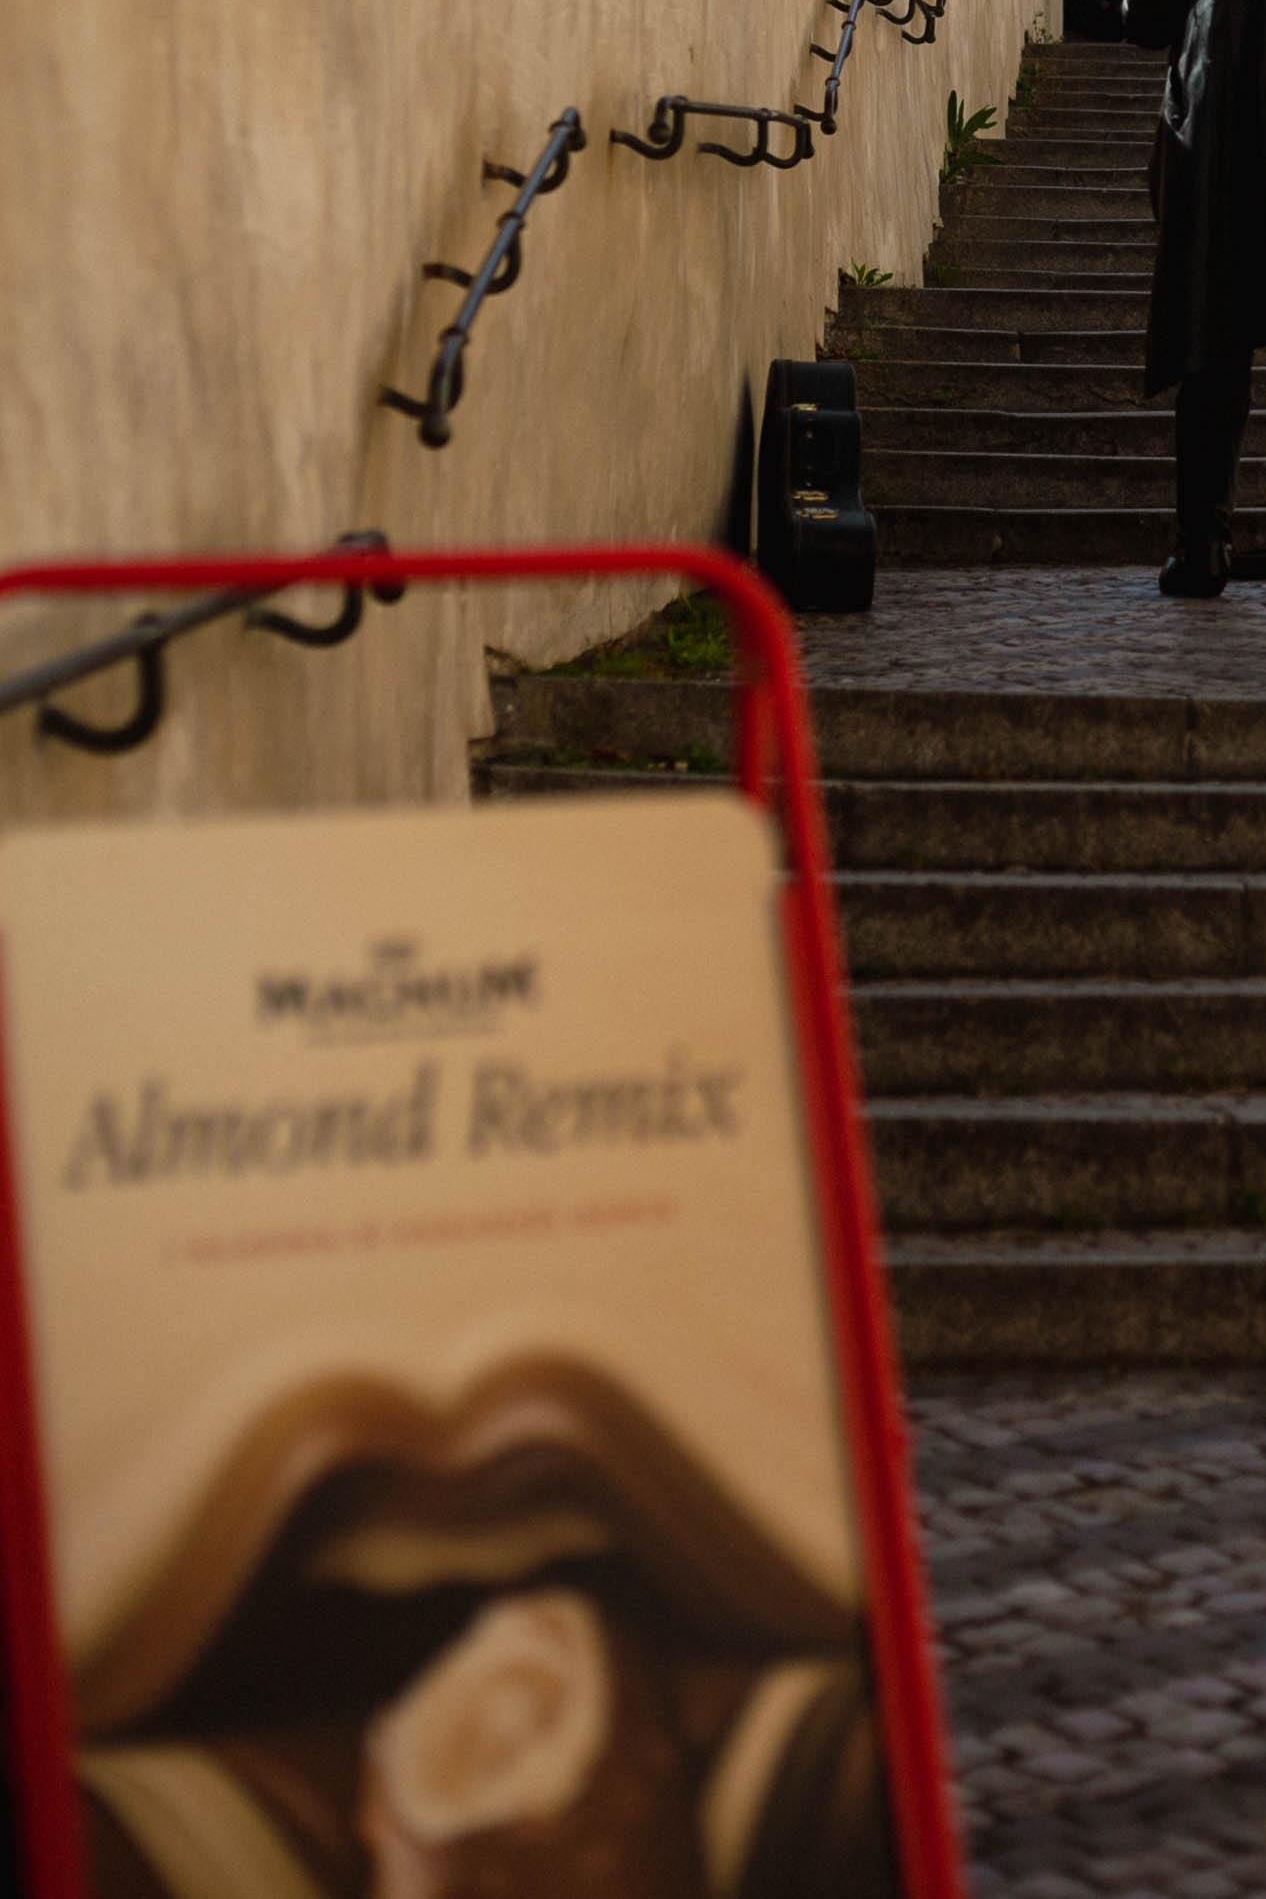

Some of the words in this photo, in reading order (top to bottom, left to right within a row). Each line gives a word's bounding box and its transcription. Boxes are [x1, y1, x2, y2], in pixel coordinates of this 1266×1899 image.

[256, 951, 542, 1028] MAGNUM
[62, 1057, 444, 1191] Almond
[466, 1043, 746, 1161] Remix
